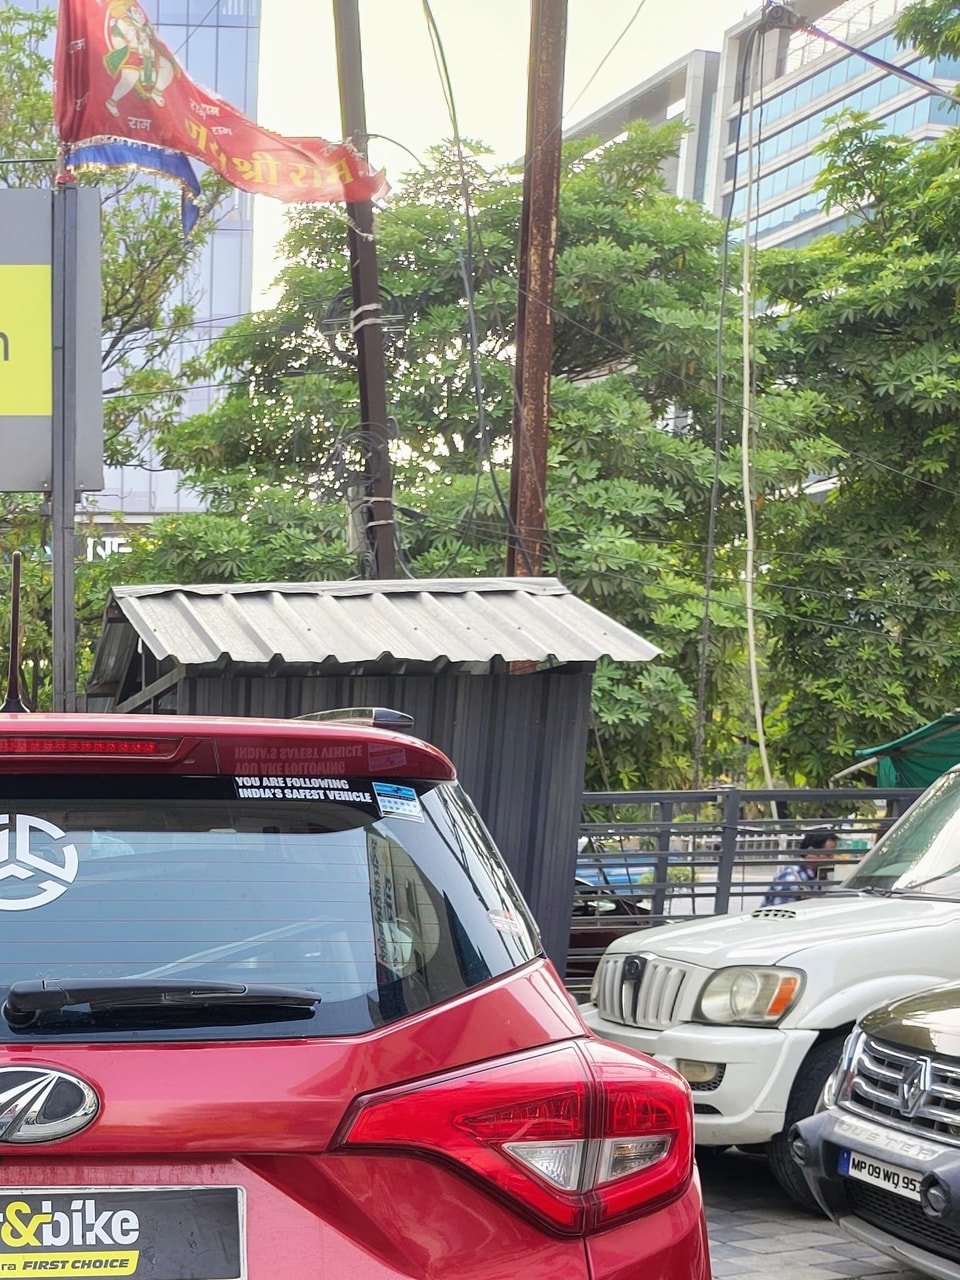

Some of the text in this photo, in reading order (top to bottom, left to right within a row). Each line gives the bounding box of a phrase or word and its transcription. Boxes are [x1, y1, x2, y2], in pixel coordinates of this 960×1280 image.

[127, 116, 152, 131] राम
[232, 151, 279, 186] श्री
[288, 156, 355, 188] राम
[234, 776, 349, 789] YOU ARE FOLLOWING
[238, 788, 282, 799] INDIA'S
[284, 788, 325, 800] SAFEST
[328, 790, 372, 803] VEHICLE
[851, 1157, 867, 1173] MP
[867, 1163, 881, 1179] 09
[22, 1260, 71, 1271] FIRST
[72, 1258, 129, 1270] CHOICE
